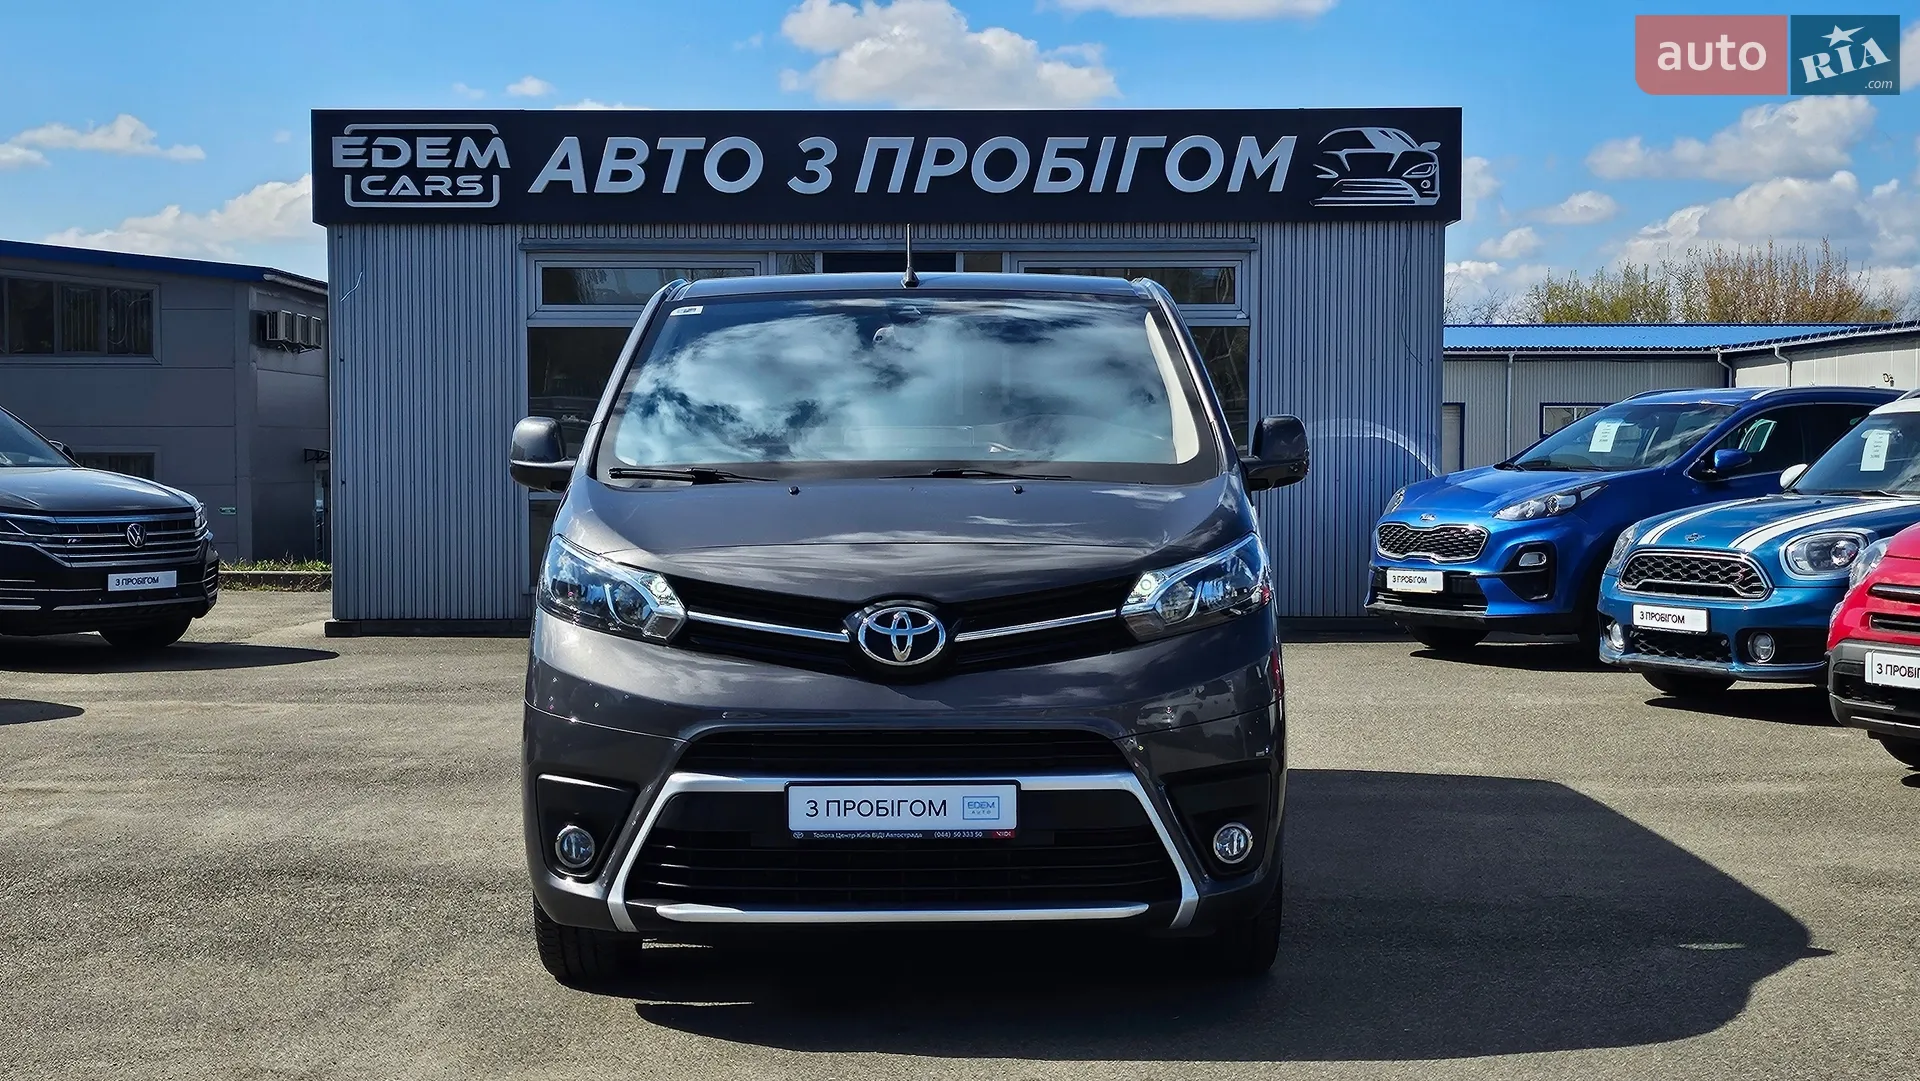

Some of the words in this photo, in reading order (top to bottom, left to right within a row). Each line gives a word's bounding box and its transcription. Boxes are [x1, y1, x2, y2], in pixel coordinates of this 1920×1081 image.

[332, 136, 511, 169] EDEM
[527, 136, 764, 194] АВТО
[786, 136, 838, 195] З
[854, 134, 1298, 195] ПРОБІГОМ
[360, 174, 484, 196] CARS
[121, 576, 159, 586] ПРОБІГОМ
[1646, 611, 1685, 624] ПРОБІГОМ
[1876, 663, 1883, 674] З
[805, 799, 819, 818] З
[826, 799, 947, 818] ПРОБІГОМ
[967, 801, 996, 810] EDEM
